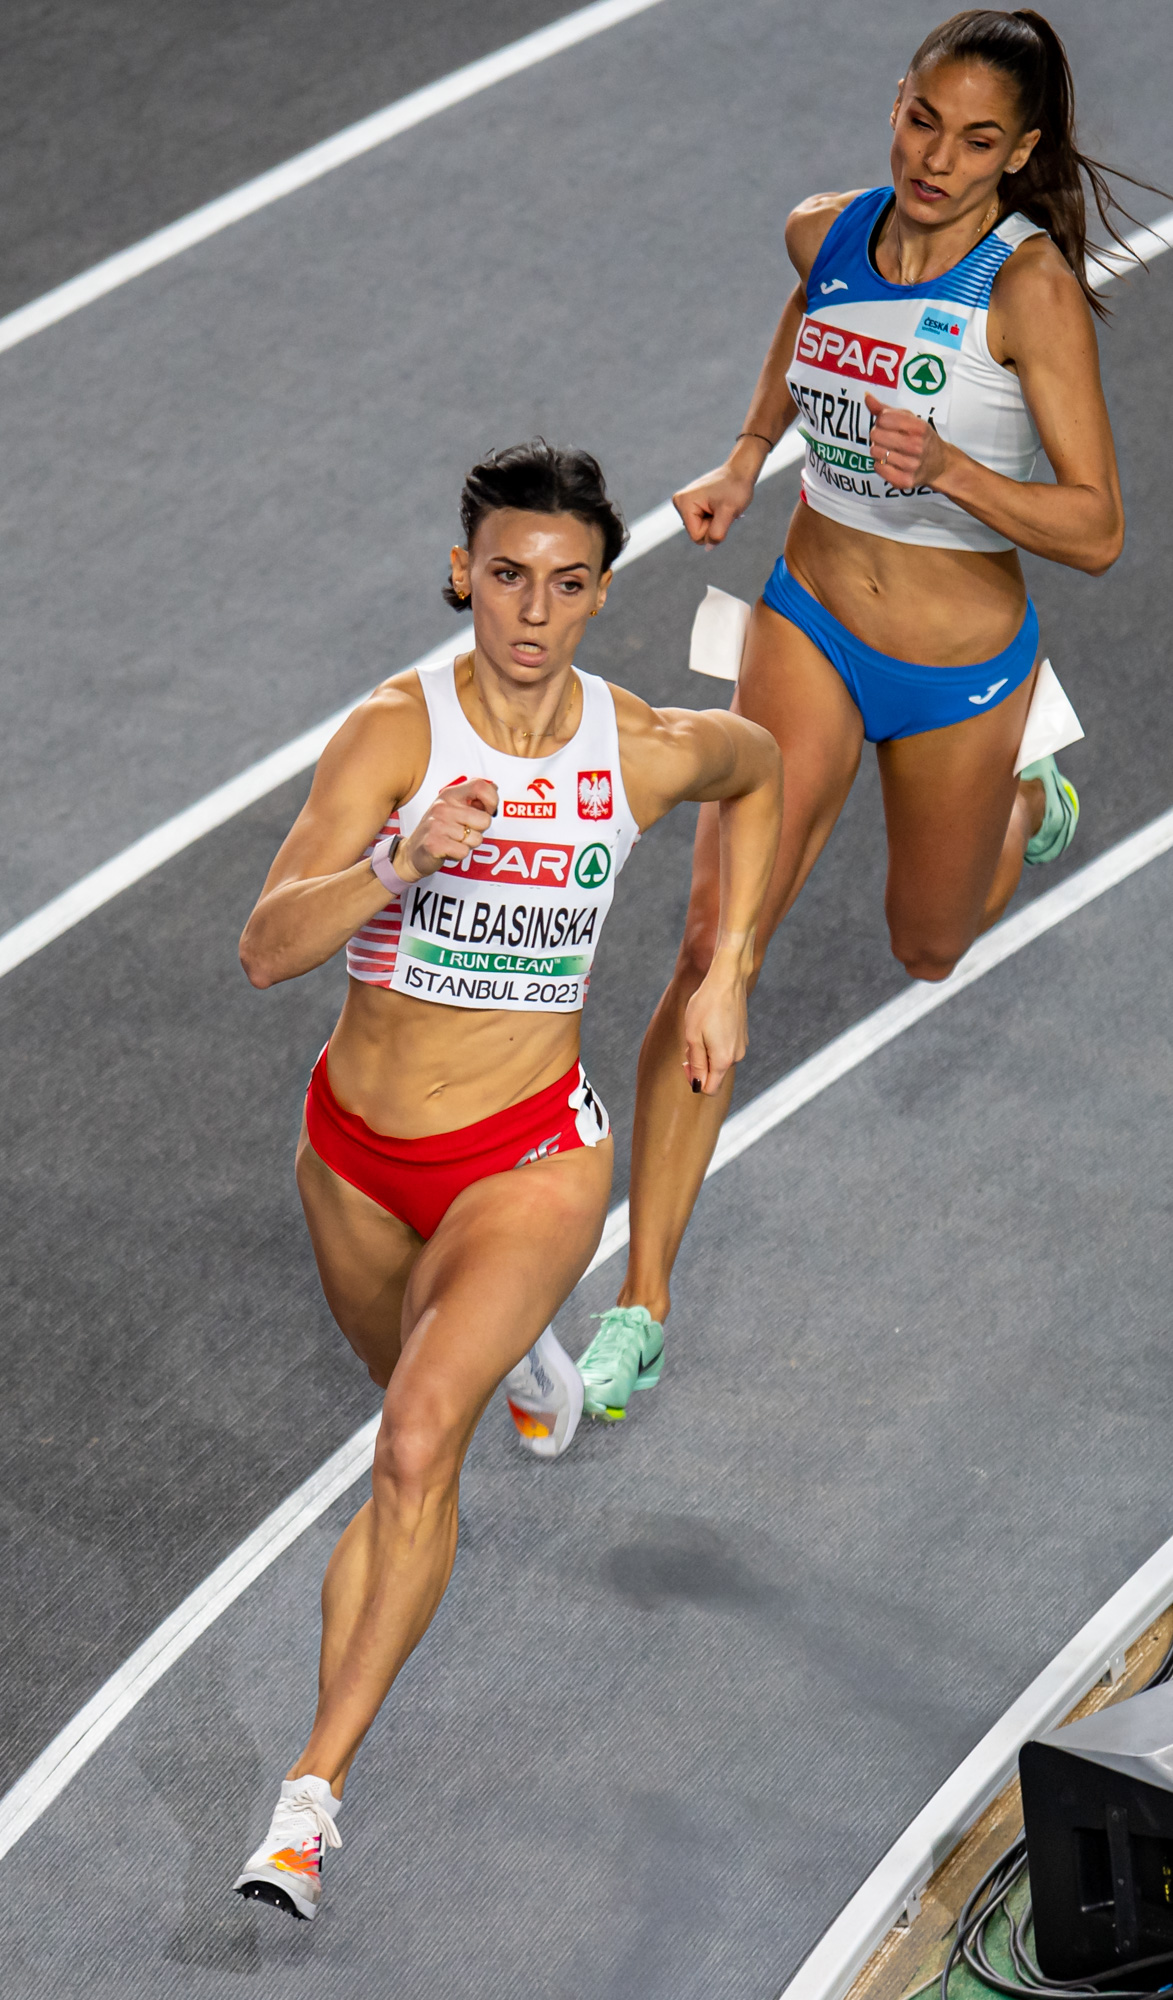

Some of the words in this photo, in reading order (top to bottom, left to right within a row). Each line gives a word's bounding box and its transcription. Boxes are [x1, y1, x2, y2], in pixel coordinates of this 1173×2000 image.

[799, 326, 900, 382] SPAR
[808, 451, 881, 499] ISTANBUL
[817, 444, 847, 465] RUN
[849, 453, 875, 472] CLE
[505, 803, 554, 817] ORLEN
[443, 843, 569, 882] PAR
[409, 886, 599, 949] KIELBASINSKA
[439, 950, 446, 964] I
[449, 952, 490, 970] RUN
[405, 965, 520, 1001] ISTANBUL
[523, 982, 579, 1004] 2023
